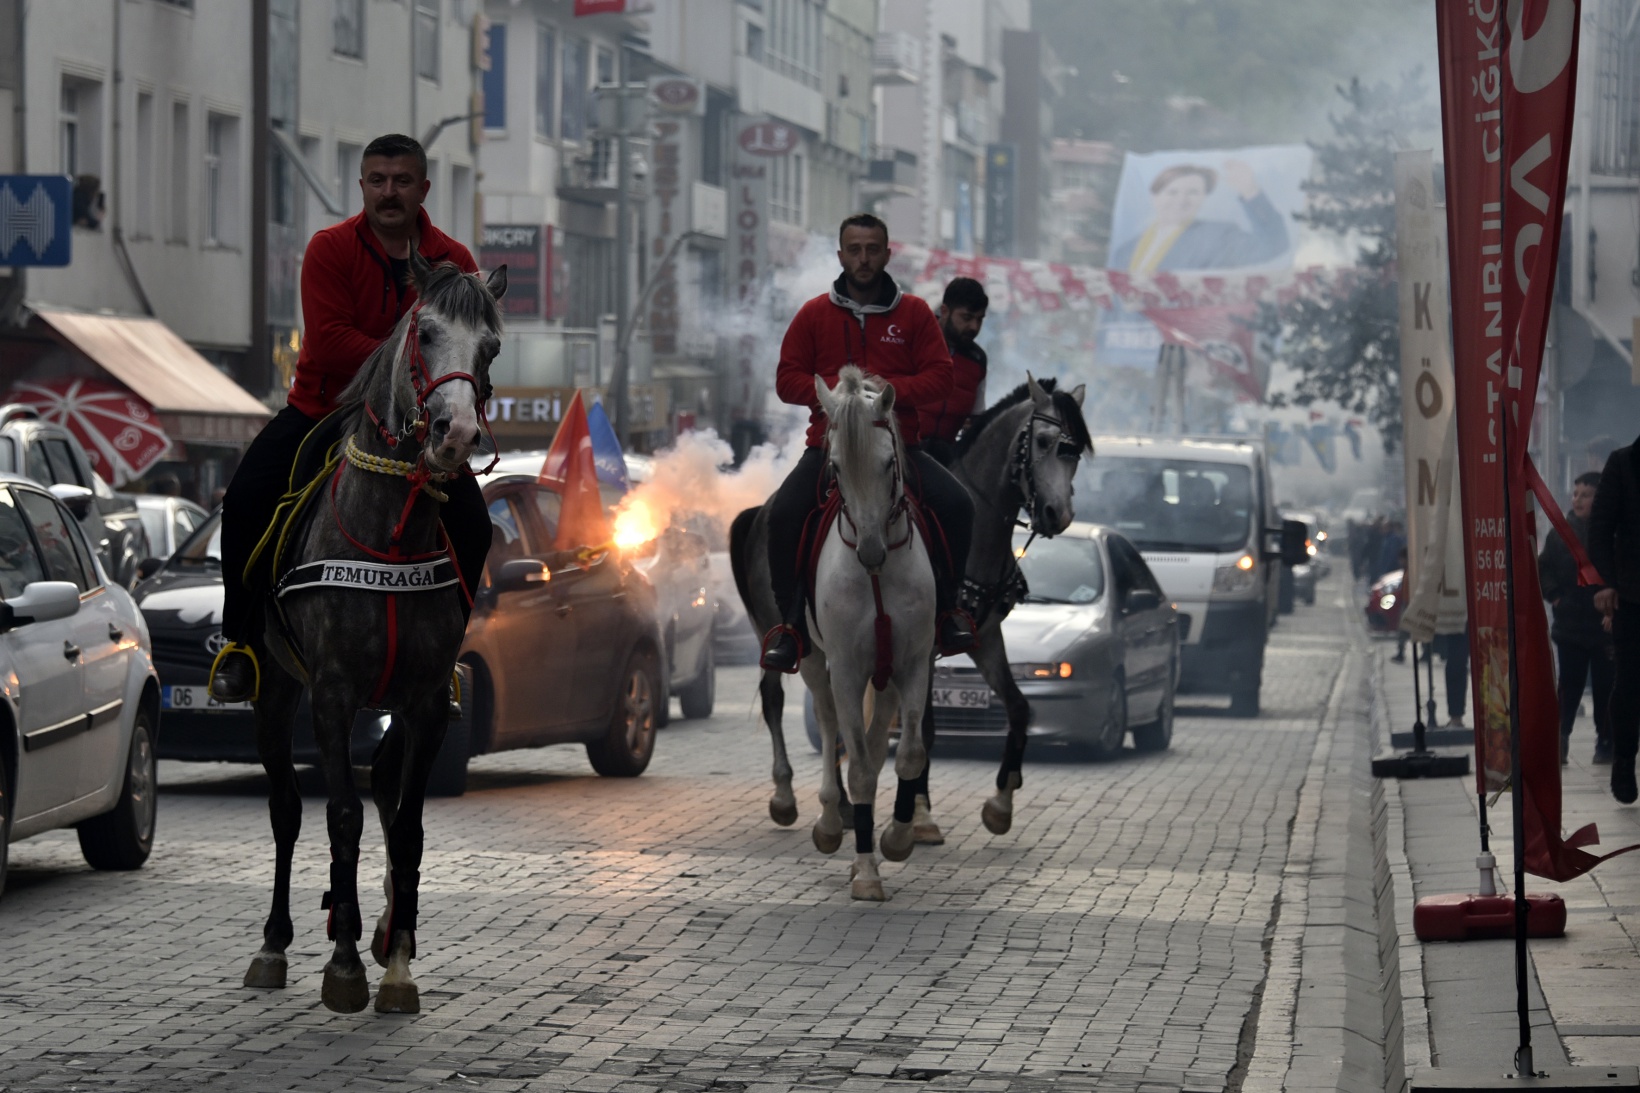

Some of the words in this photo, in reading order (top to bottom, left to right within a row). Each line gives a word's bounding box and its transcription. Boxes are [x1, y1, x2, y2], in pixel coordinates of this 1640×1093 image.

[1413, 281, 1443, 507] KÖM
[324, 565, 434, 588] TEMURAĞA
[174, 686, 193, 707] 06
